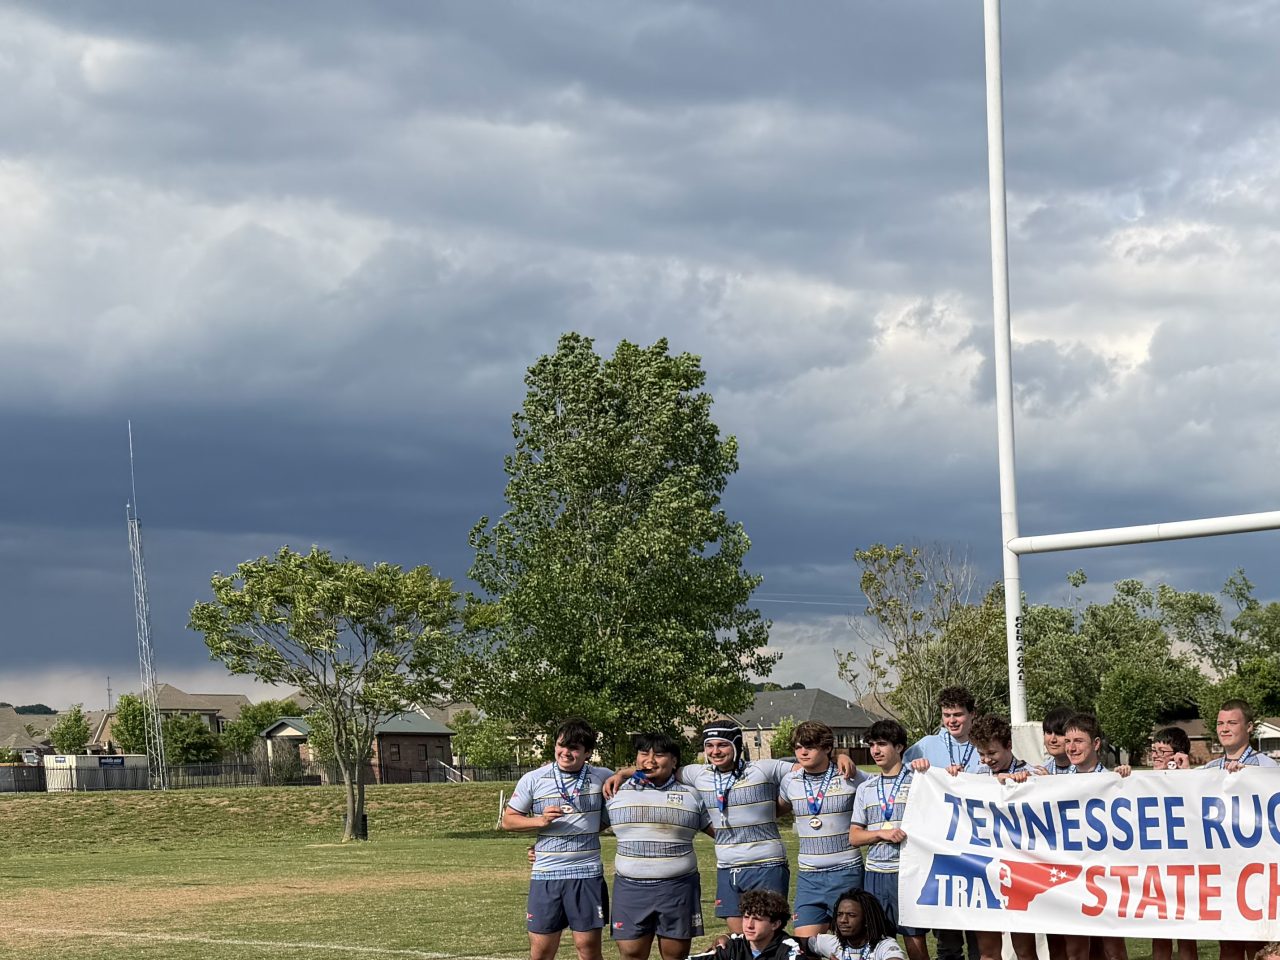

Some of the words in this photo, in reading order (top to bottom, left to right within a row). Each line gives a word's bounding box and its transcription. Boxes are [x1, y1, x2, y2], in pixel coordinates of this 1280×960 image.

[944, 793, 1188, 851] TENNESSEE
[934, 874, 989, 909] TRA
[1081, 864, 1222, 921] STATE
